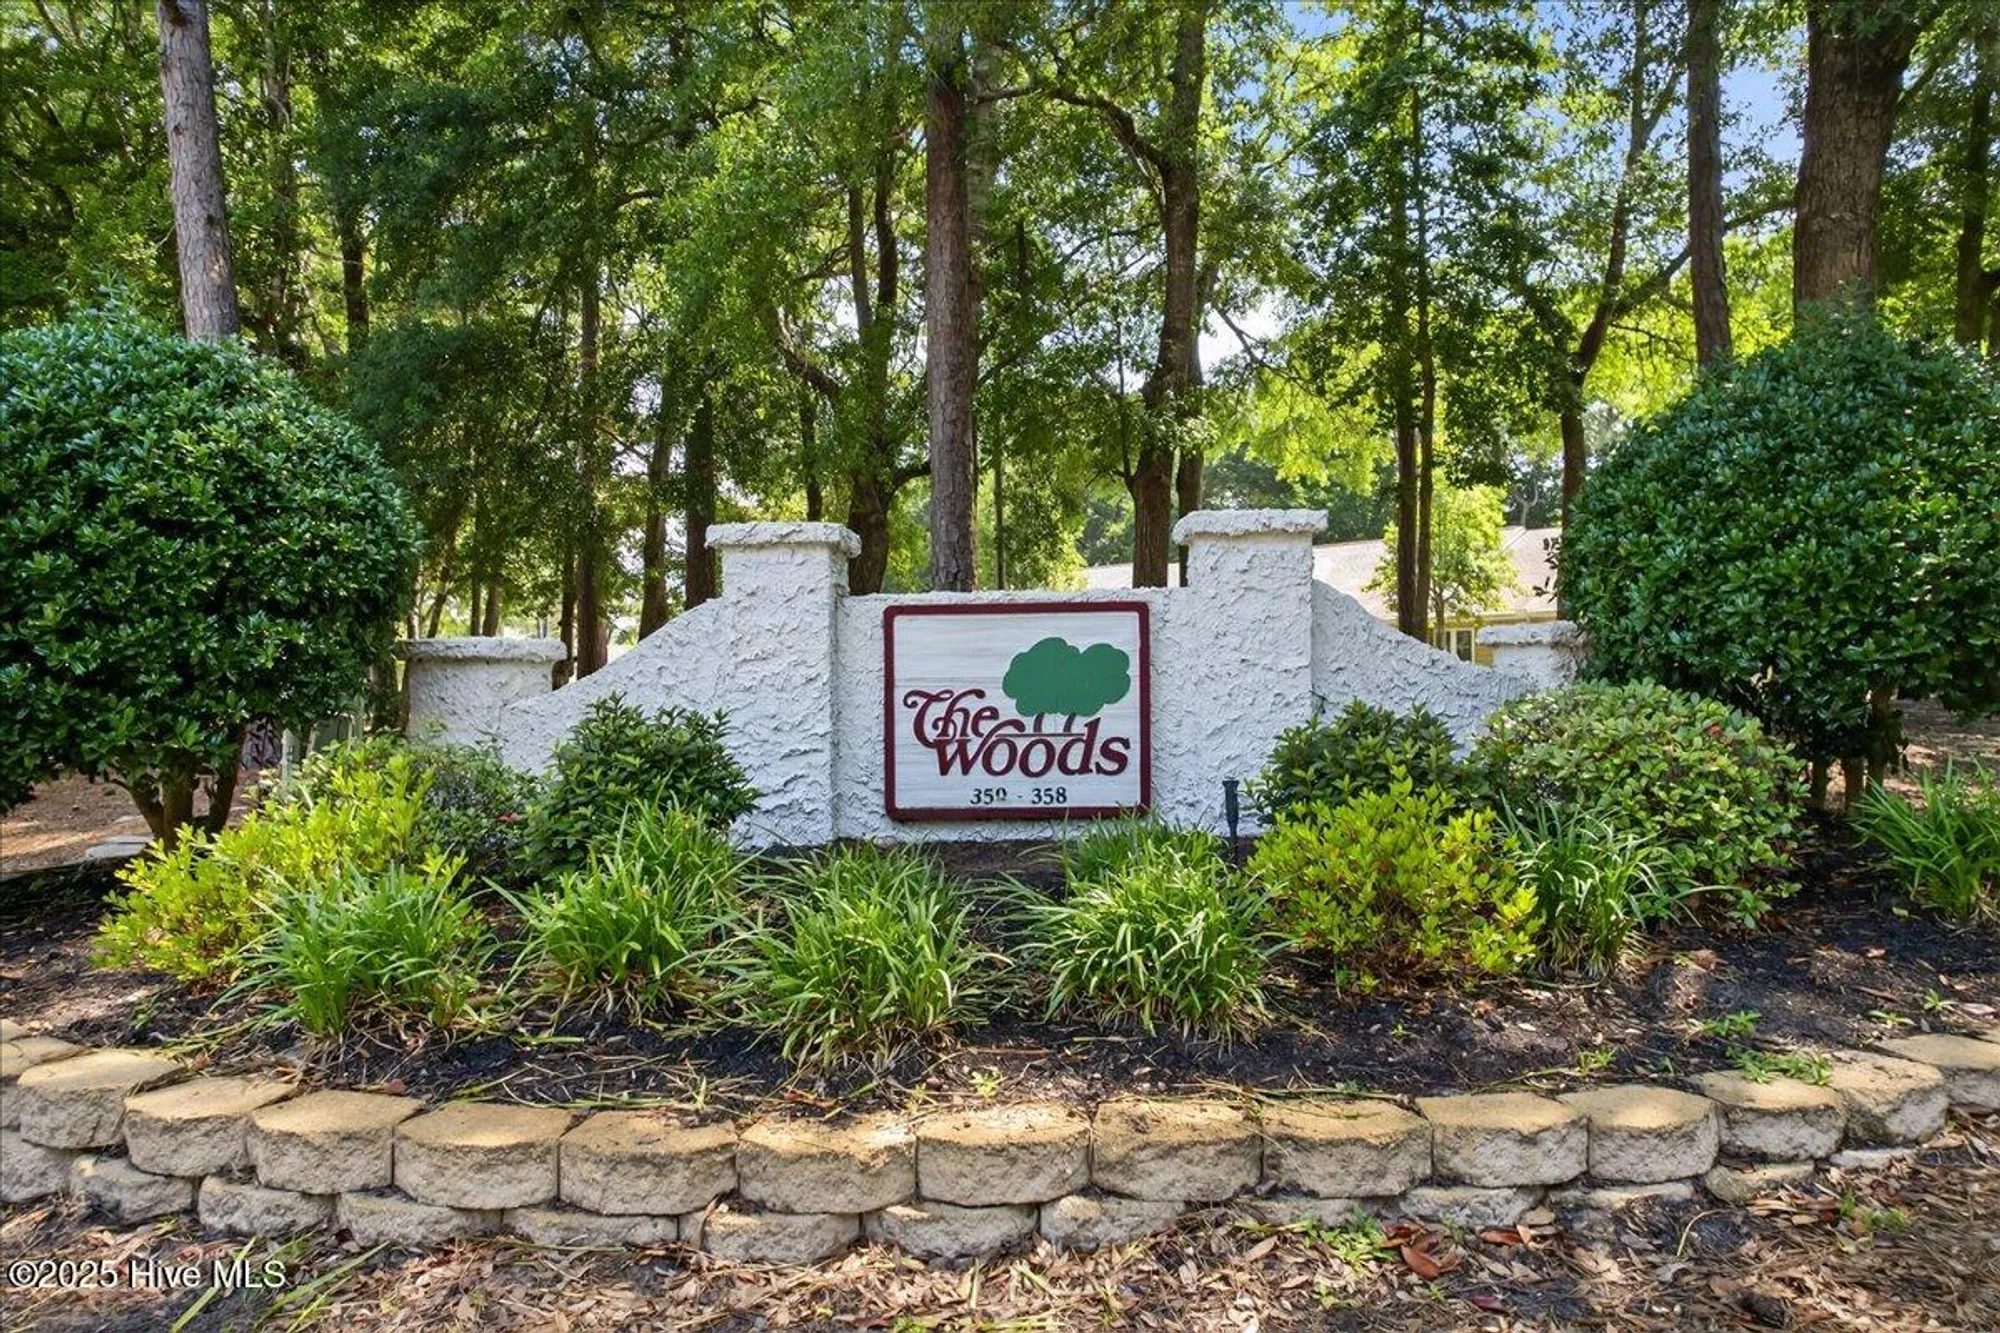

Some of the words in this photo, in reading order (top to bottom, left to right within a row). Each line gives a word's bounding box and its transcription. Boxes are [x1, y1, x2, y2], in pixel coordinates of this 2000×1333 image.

[903, 688, 1000, 749] The
[932, 716, 1132, 778] Woods
[1031, 787, 1067, 804] 358
